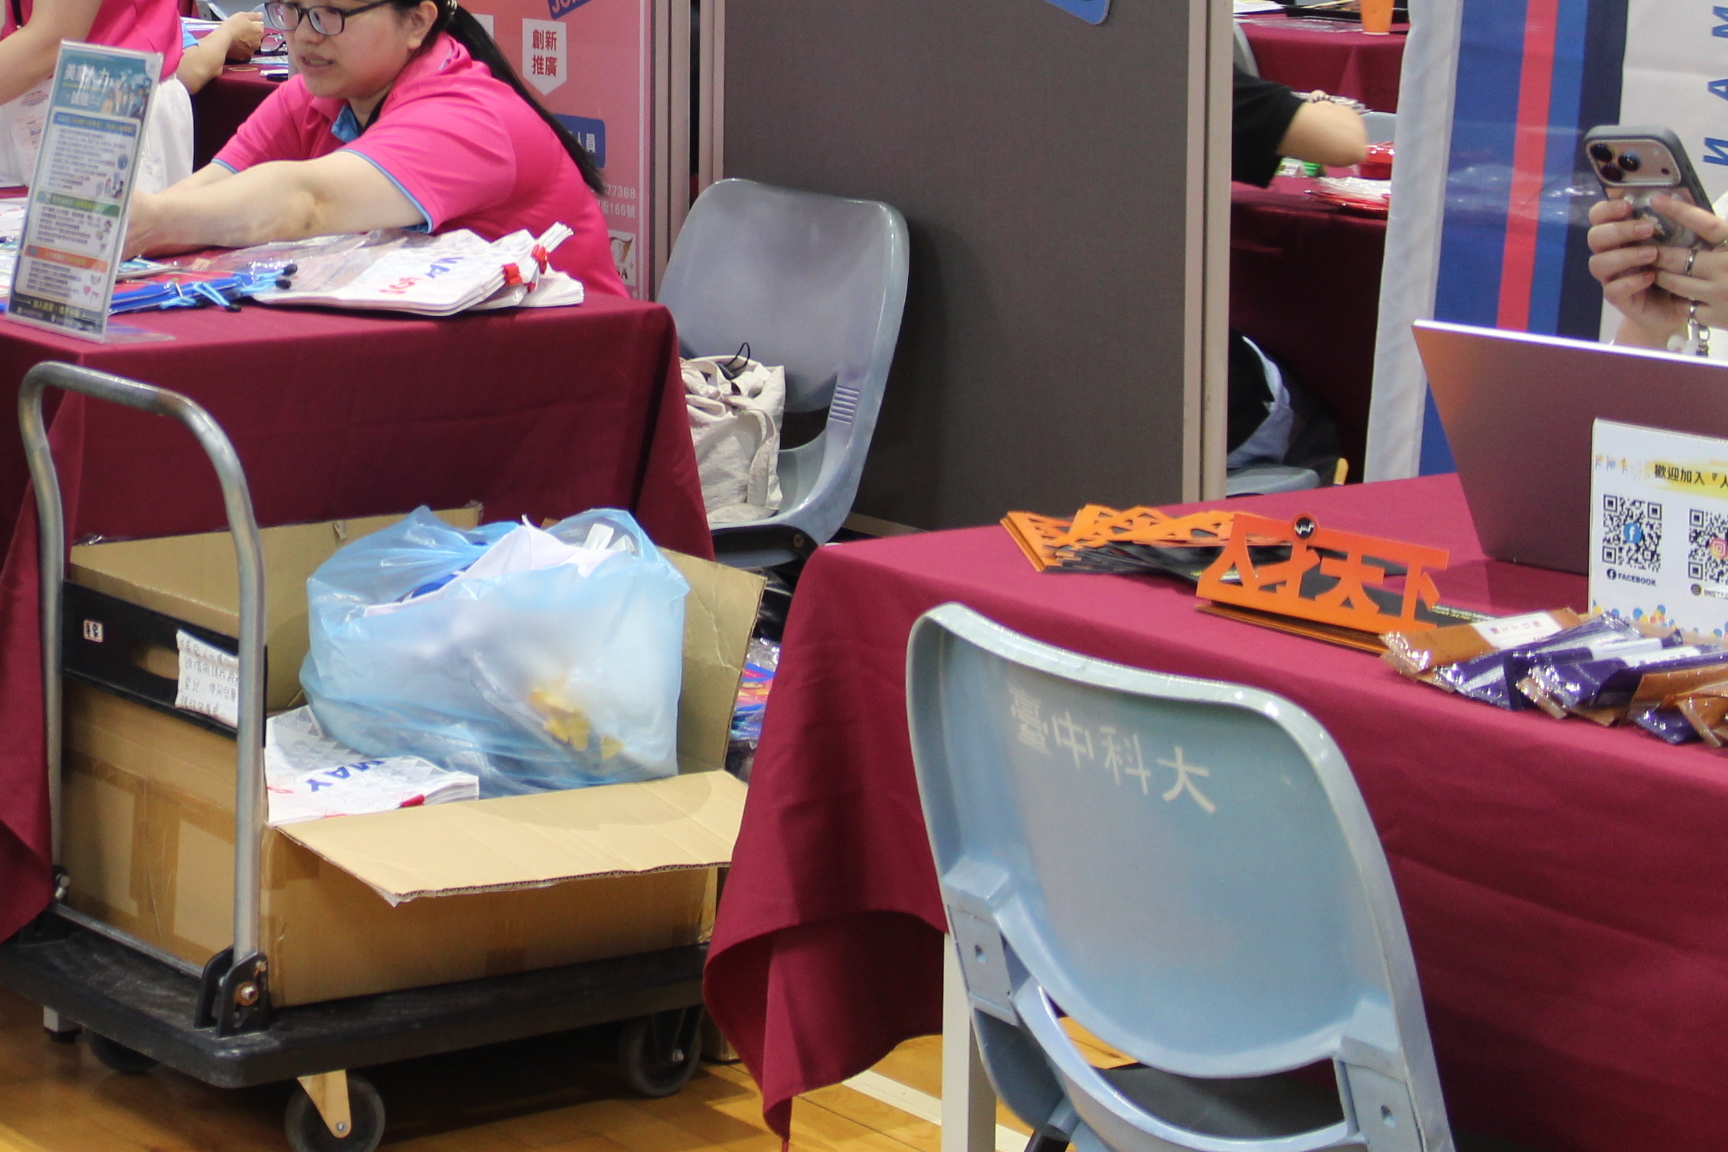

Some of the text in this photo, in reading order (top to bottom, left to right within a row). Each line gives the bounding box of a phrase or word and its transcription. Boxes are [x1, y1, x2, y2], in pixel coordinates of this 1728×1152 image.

[531, 29, 558, 51] 創新
[532, 55, 558, 77] 推廣
[1618, 572, 1657, 587] FACEBOOK
